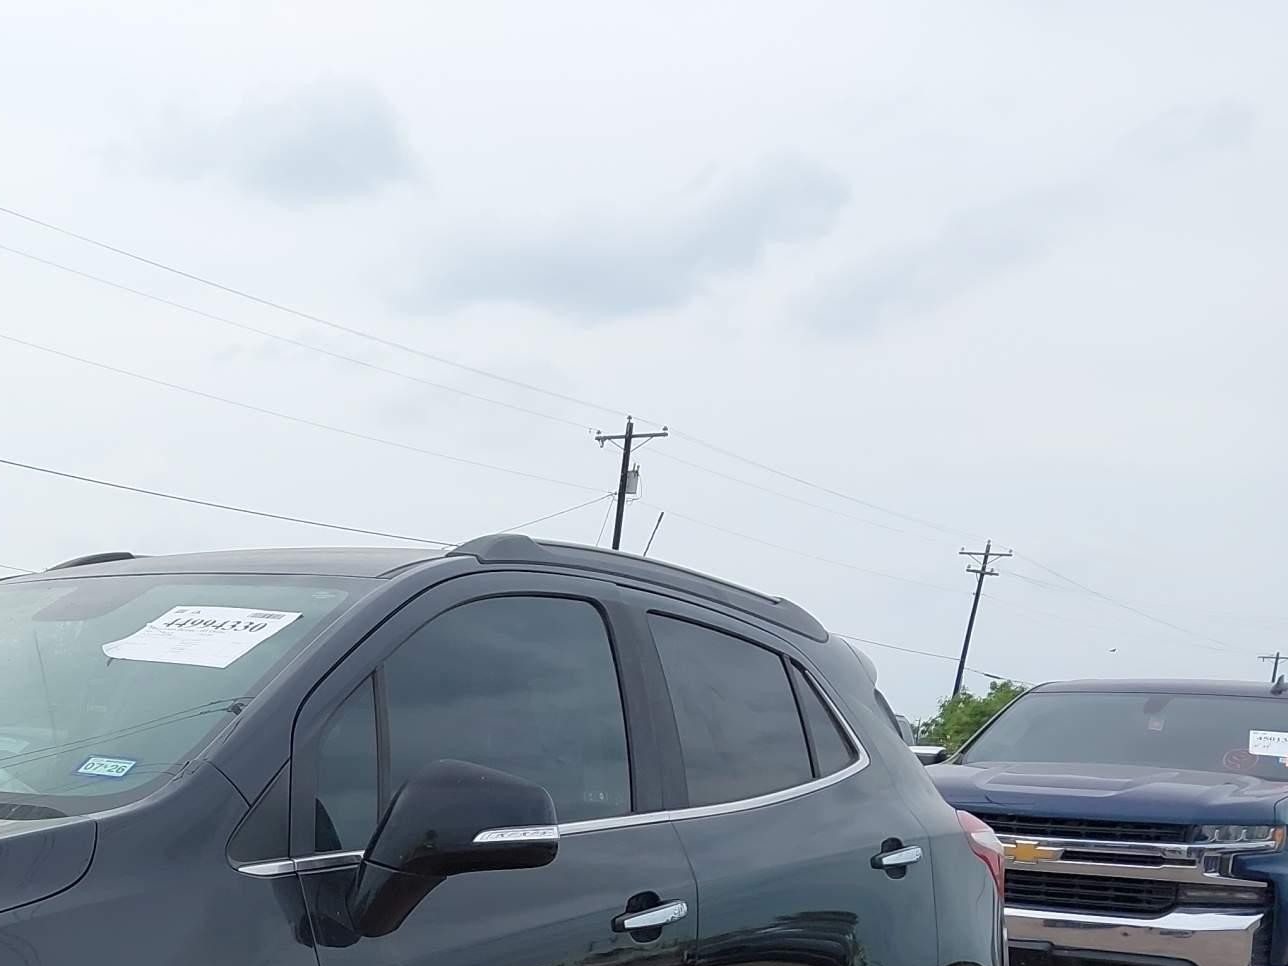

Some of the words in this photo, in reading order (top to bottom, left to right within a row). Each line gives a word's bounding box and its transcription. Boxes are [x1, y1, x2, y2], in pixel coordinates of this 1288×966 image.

[163, 617, 268, 633] 44994330
[83, 762, 104, 771] 07
[107, 764, 127, 774] 26
